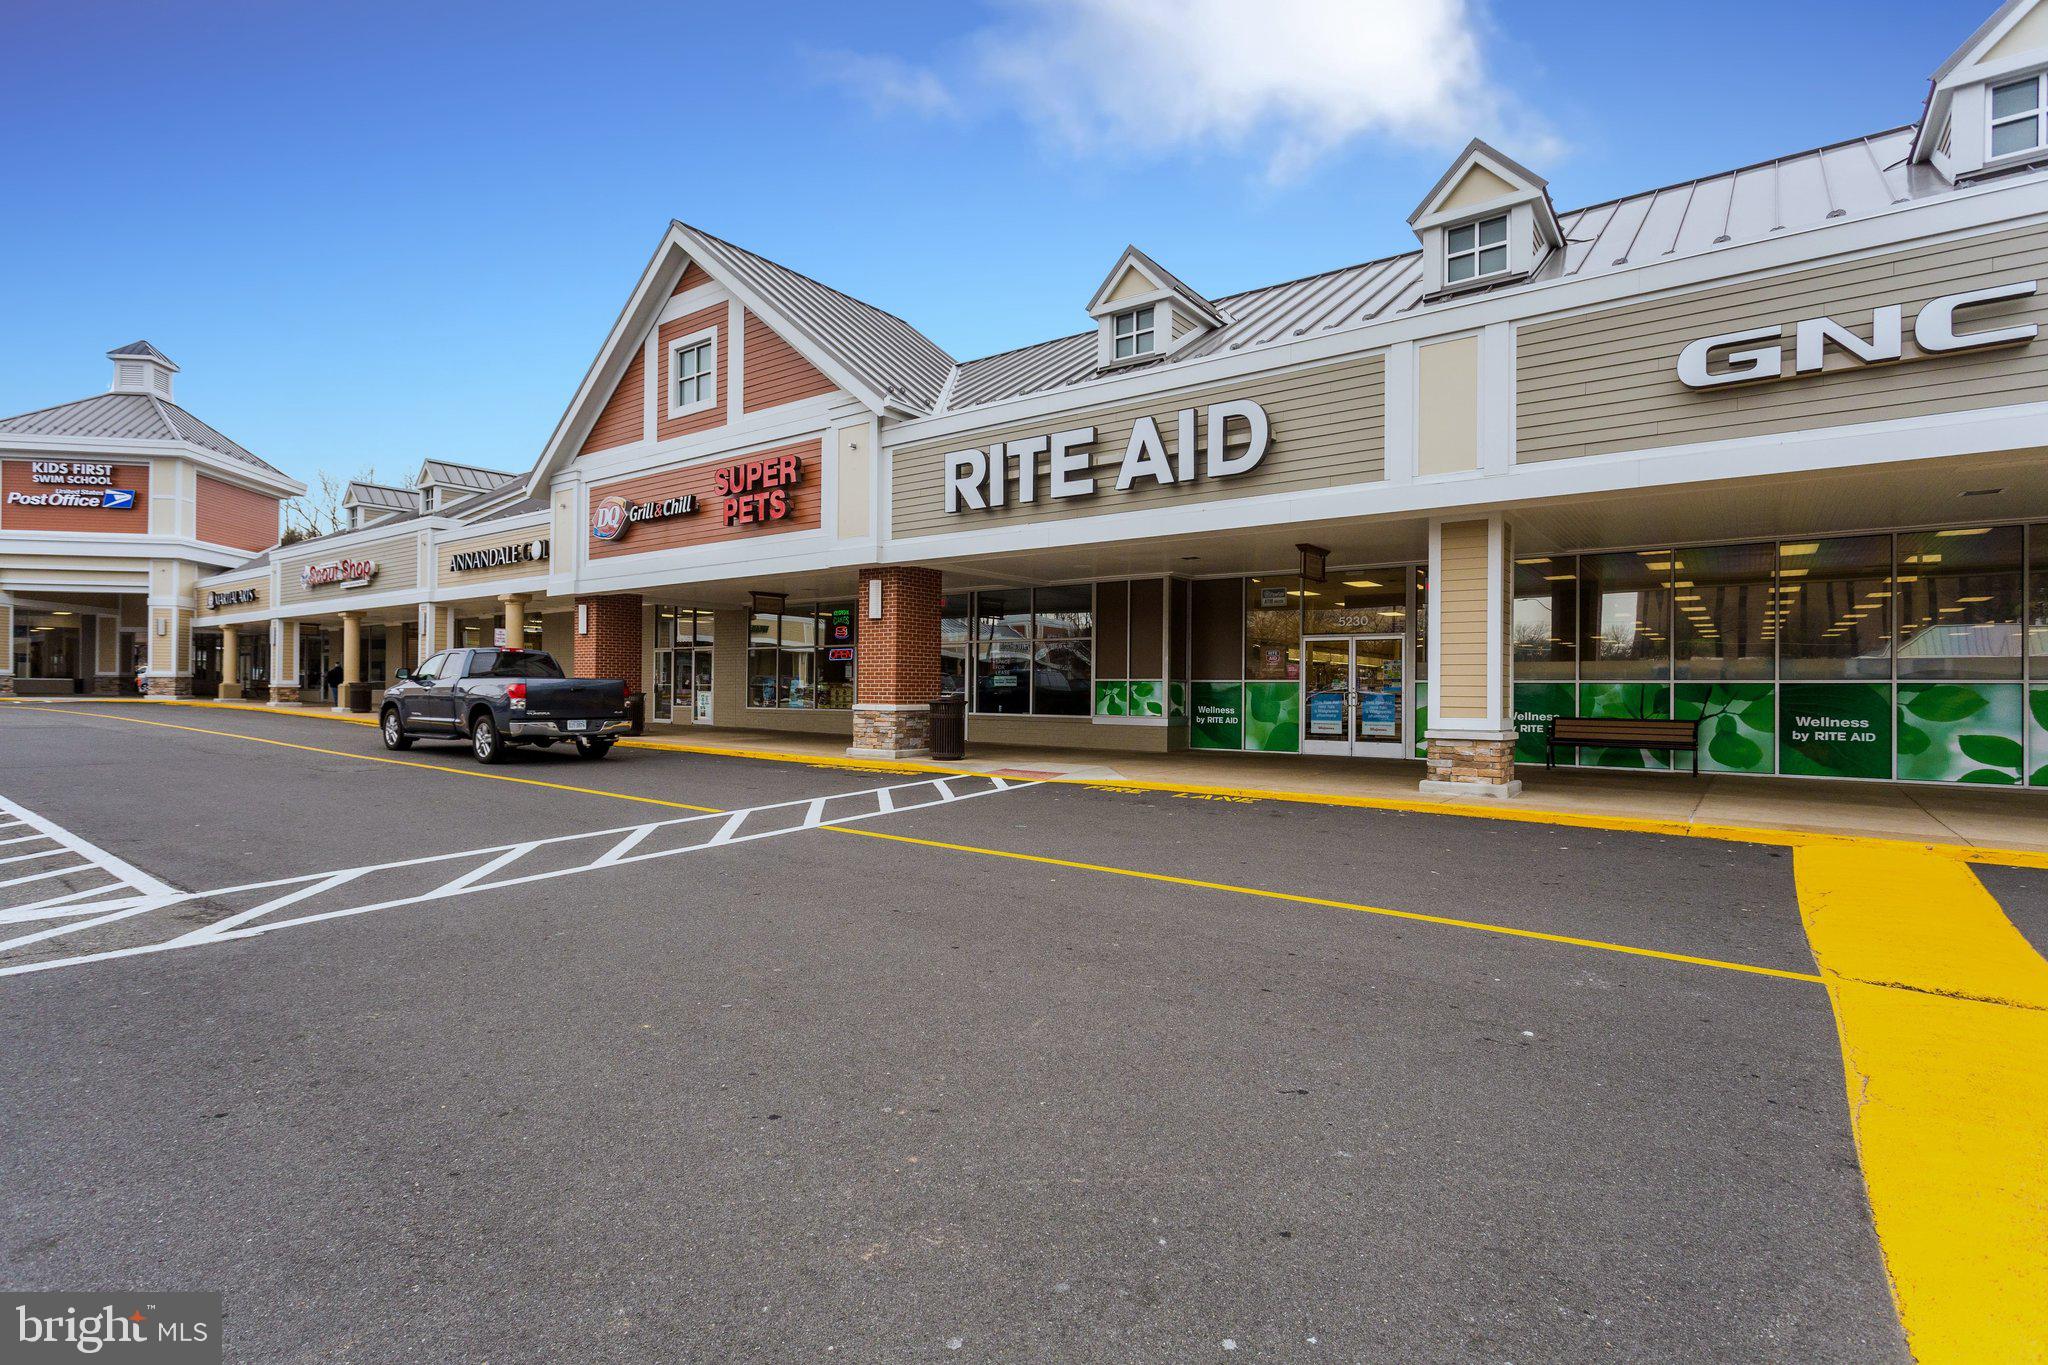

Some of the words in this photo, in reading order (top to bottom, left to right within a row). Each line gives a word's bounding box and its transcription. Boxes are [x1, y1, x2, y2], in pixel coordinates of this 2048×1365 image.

[1676, 280, 2039, 389] GNC
[944, 426, 1098, 513] RITE
[1114, 399, 1273, 490] AID
[32, 462, 69, 474] KIDS
[73, 463, 113, 476] FIRST
[714, 454, 799, 497] SUPER
[32, 474, 65, 483] SWIM
[67, 475, 113, 485] SCHOOL
[7, 492, 49, 505] Post
[48, 494, 100, 506] Office
[723, 489, 787, 527] PETS
[597, 505, 620, 528] DQ
[450, 544, 518, 571] ANNANDALE
[341, 559, 371, 581] Shop
[1339, 615, 1369, 627] 5230
[831, 650, 852, 659] OPEN
[1198, 705, 1235, 714] Wellness
[1196, 715, 1206, 724] by
[1207, 716, 1224, 724] RITE
[1795, 716, 1870, 728] Wellness
[1520, 724, 1544, 733] RITE
[1792, 730, 1810, 742] by
[1814, 731, 1847, 741] RITE
[1850, 732, 1877, 742] AID
